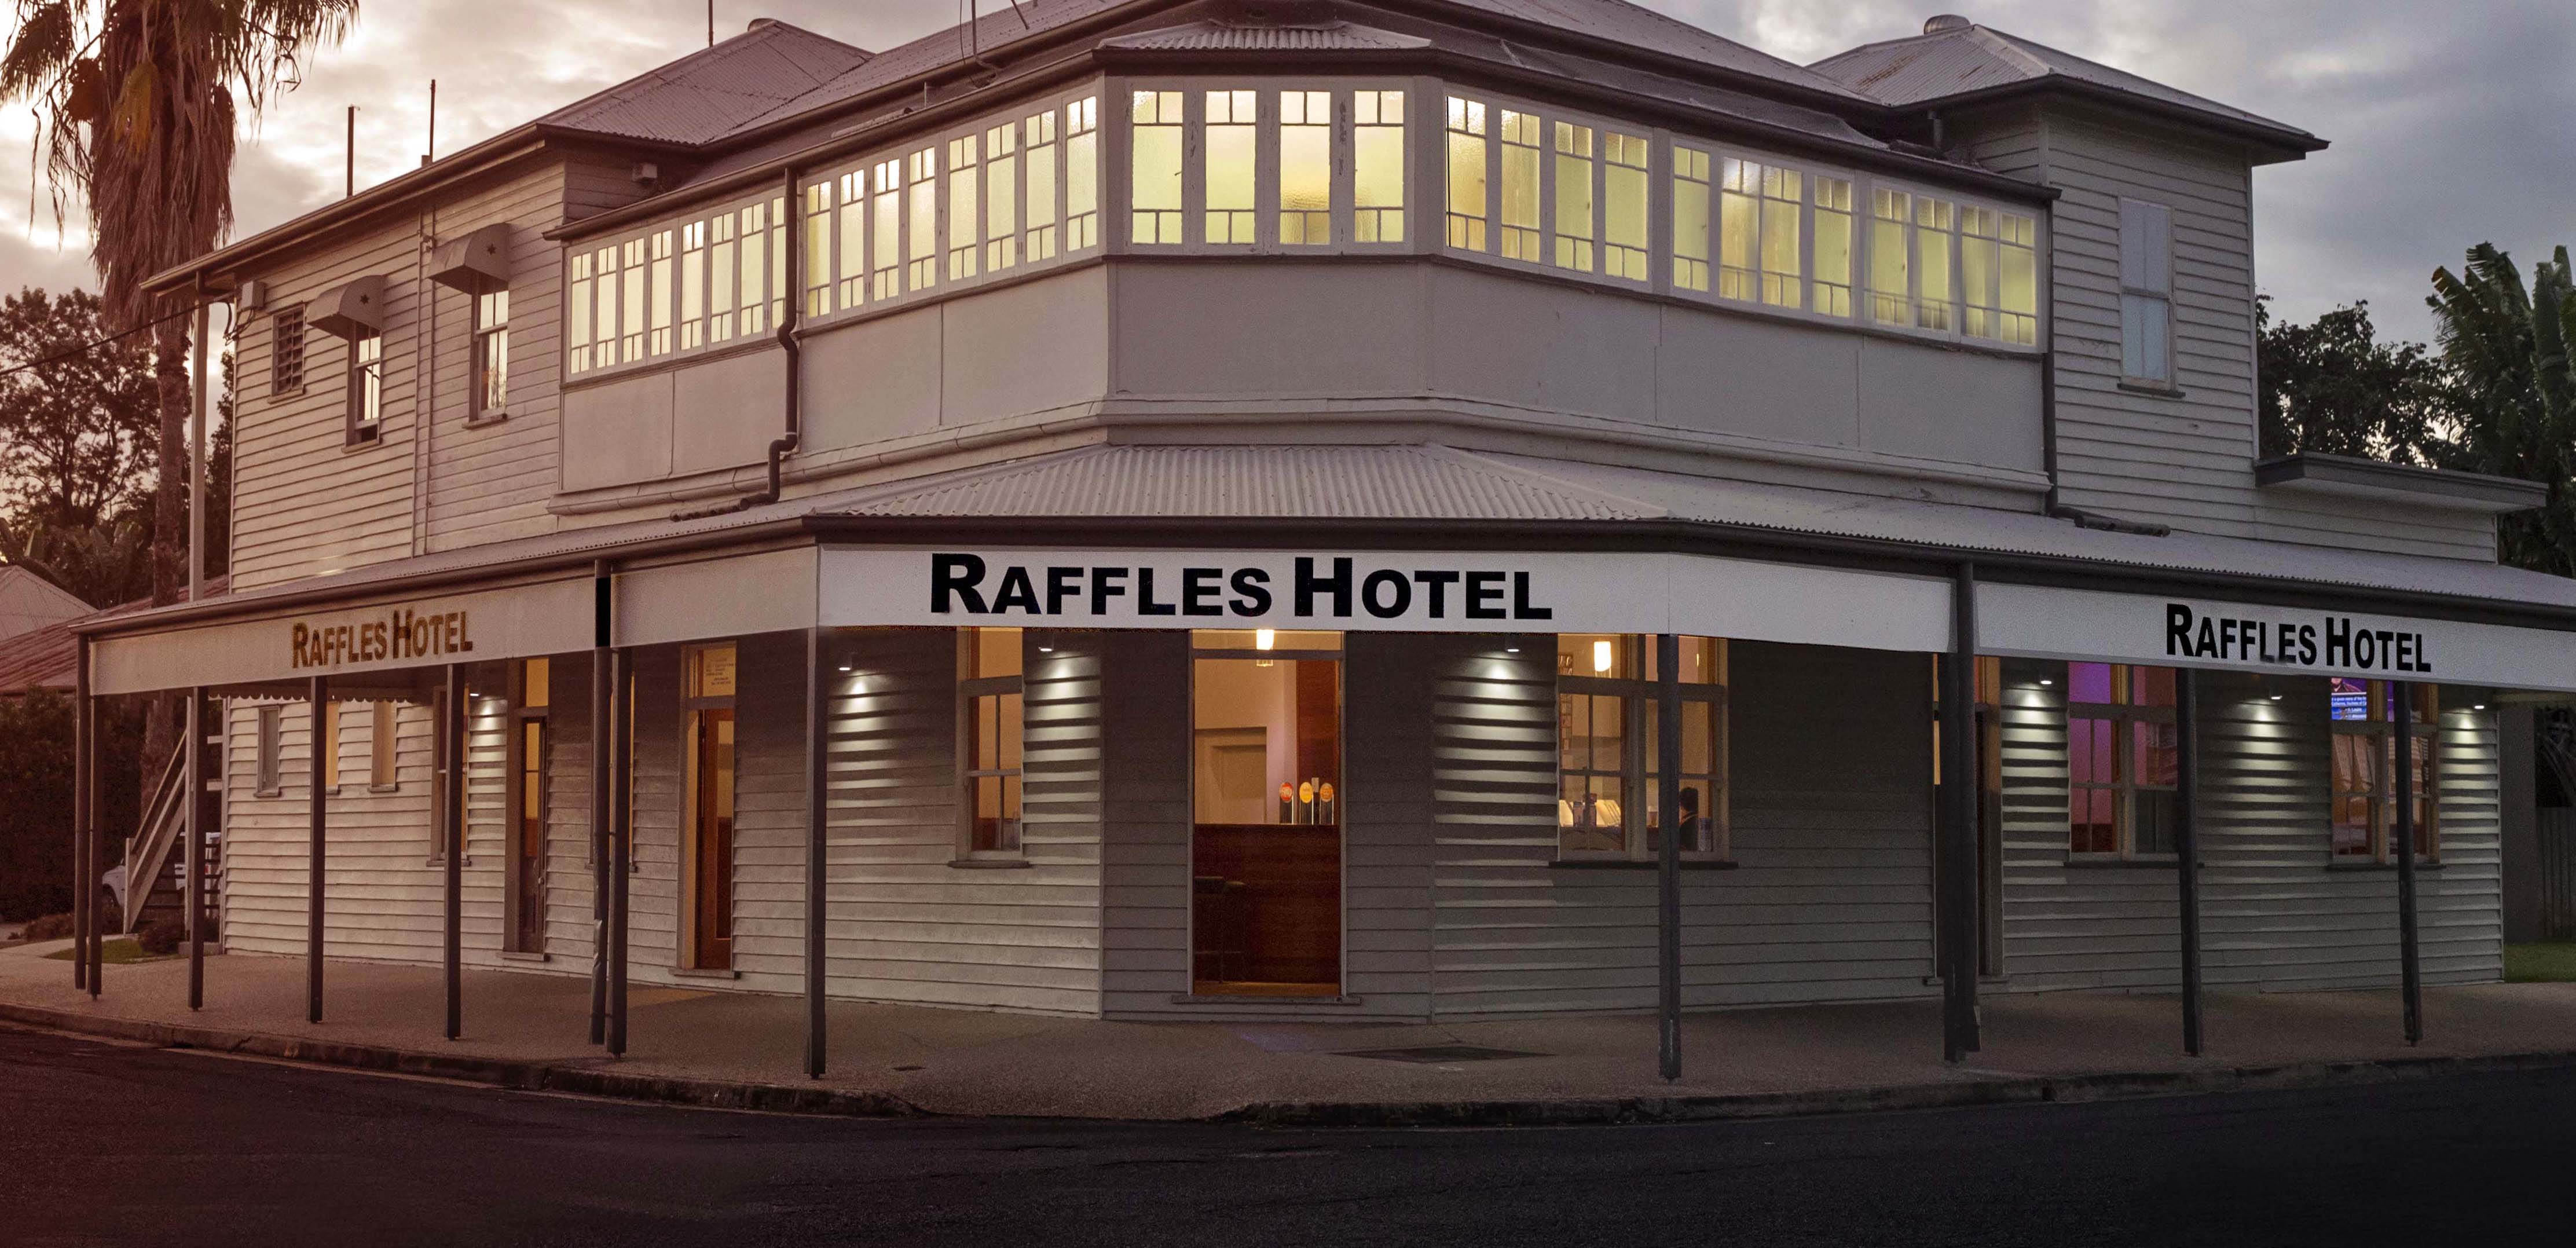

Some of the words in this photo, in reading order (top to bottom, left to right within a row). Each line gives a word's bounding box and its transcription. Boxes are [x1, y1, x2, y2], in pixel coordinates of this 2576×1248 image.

[930, 553, 1272, 617] RAFFLES
[1295, 557, 1552, 620] HOTEL
[292, 621, 387, 668] RAFFLES
[393, 609, 473, 658] HOTEL
[2167, 603, 2317, 665] RAFFLES
[2326, 617, 2431, 672] HOTEL
